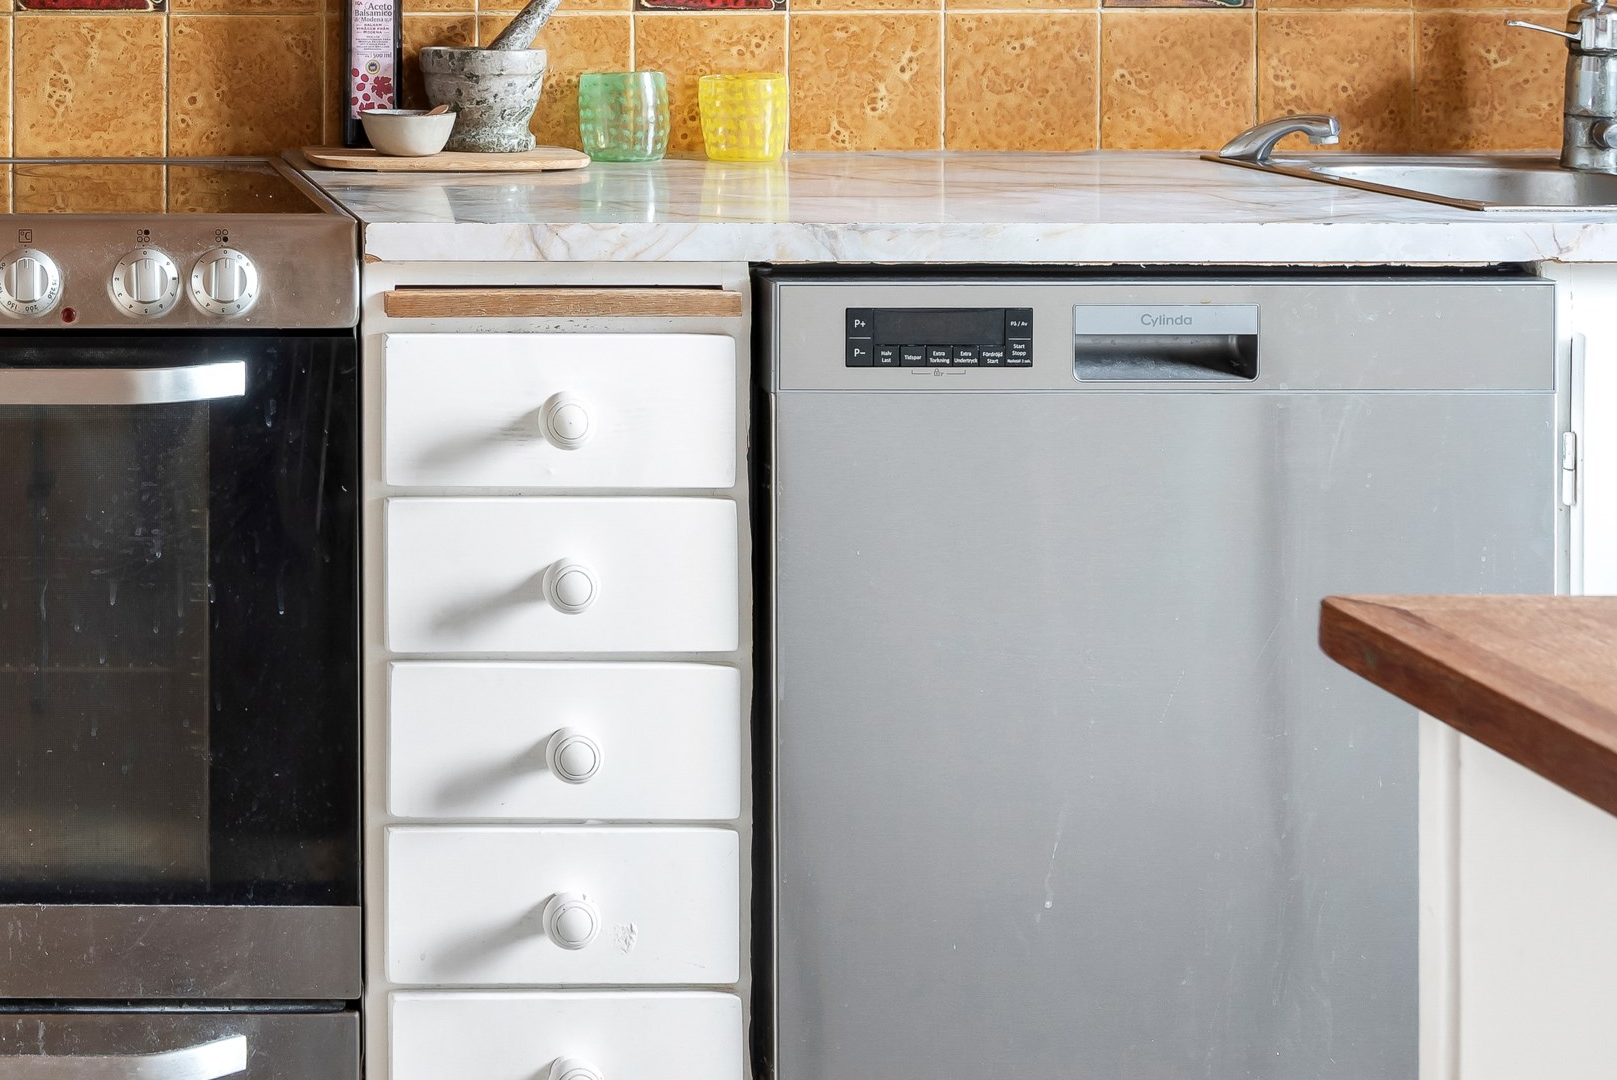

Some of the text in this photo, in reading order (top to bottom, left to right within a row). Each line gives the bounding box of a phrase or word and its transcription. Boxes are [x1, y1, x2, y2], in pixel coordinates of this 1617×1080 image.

[365, 2, 392, 10] Aceto
[0, 262, 6, 270] 50
[7, 300, 18, 309] 150
[854, 319, 866, 328] P+
[1140, 313, 1192, 327] Cylinda
